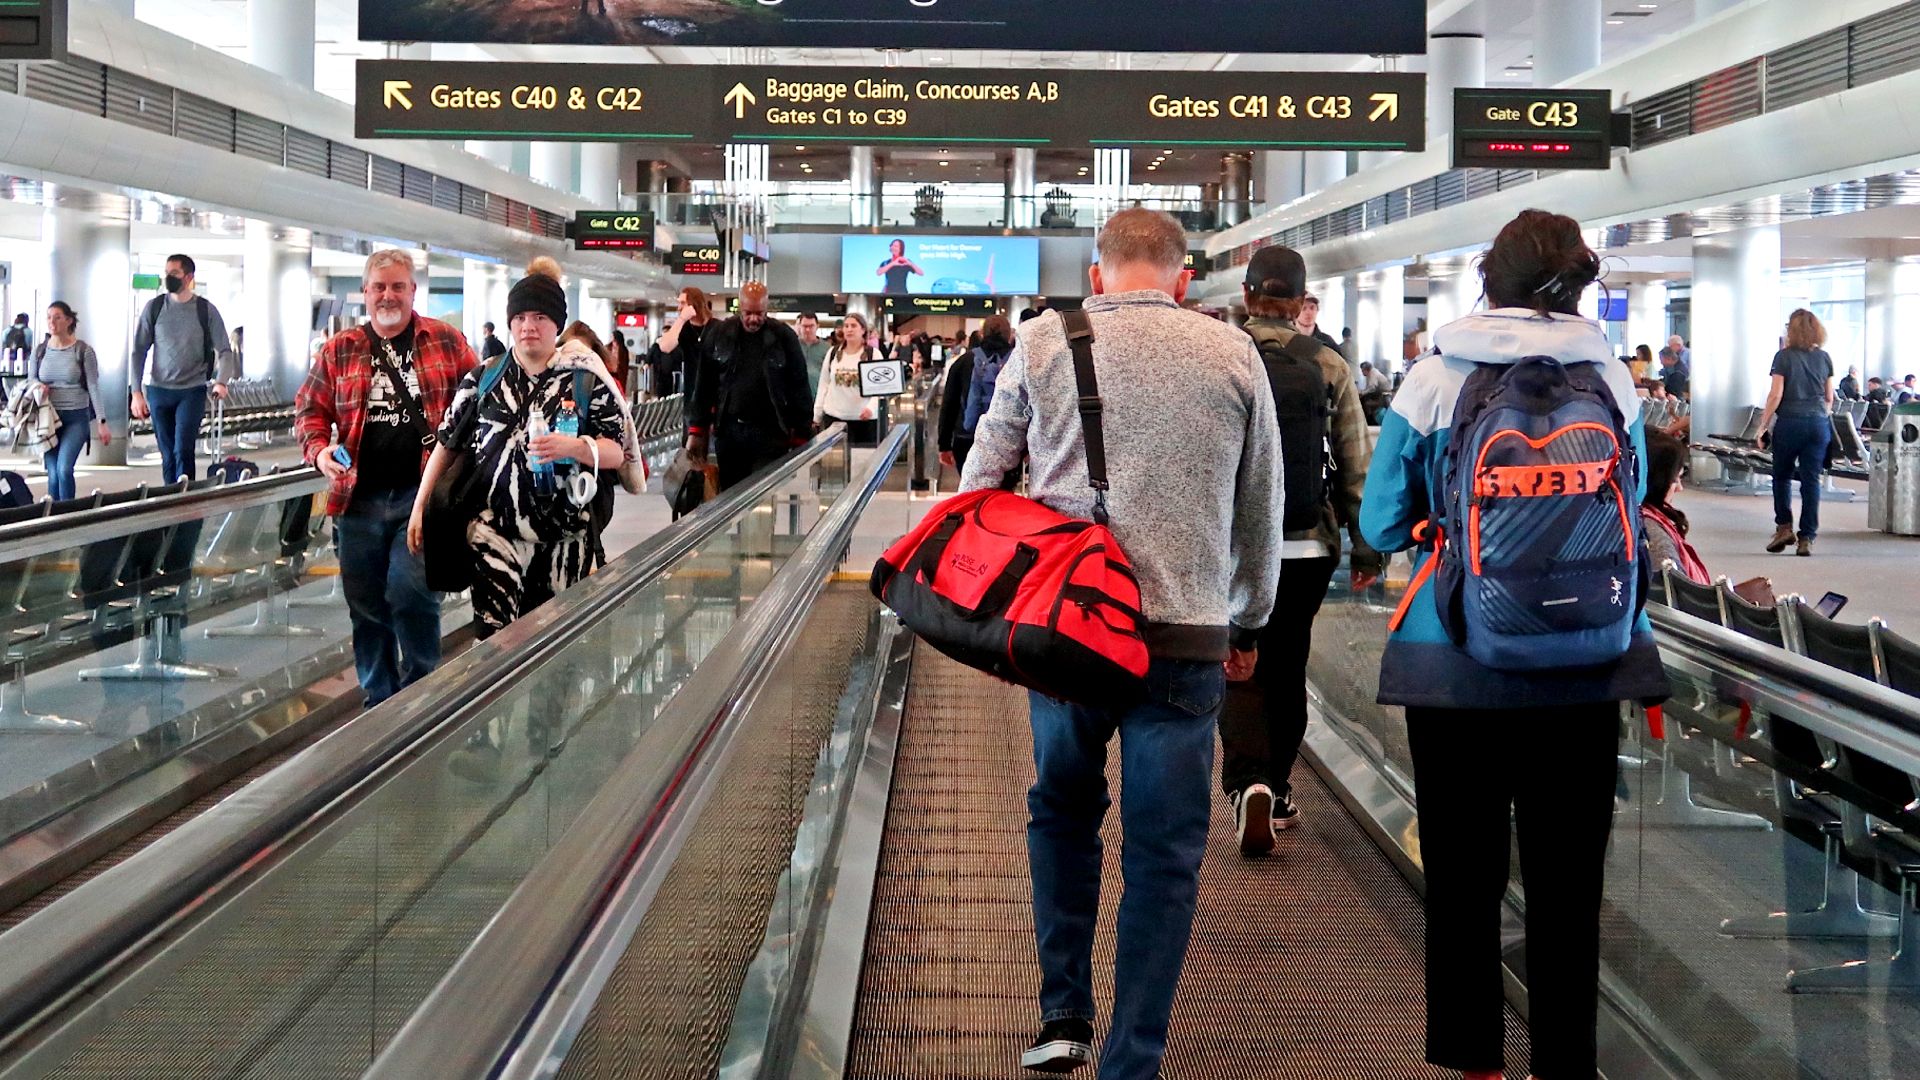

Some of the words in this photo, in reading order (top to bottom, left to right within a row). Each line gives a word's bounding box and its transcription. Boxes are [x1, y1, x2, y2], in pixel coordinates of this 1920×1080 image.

[430, 84, 501, 109] Gates
[511, 85, 557, 110] C40
[568, 87, 586, 110] &
[597, 87, 642, 111] C42
[766, 78, 848, 103] Baggage
[854, 79, 909, 101] Claim,
[915, 80, 1020, 101] Concourses
[1026, 81, 1059, 103] A,B
[766, 107, 816, 124] Gates
[822, 108, 842, 124] C1
[848, 109, 868, 124] to
[874, 109, 907, 125] C39
[1148, 94, 1220, 118] Gates
[1228, 95, 1269, 118] C41
[1278, 95, 1297, 118] &
[1306, 95, 1352, 119] C43
[1486, 106, 1521, 121] Gate
[1527, 101, 1578, 127] C43
[590, 218, 609, 229] Gate
[613, 216, 640, 231] C42
[682, 250, 698, 258] Gate
[698, 248, 720, 261] C40
[913, 298, 950, 306] Concourses
